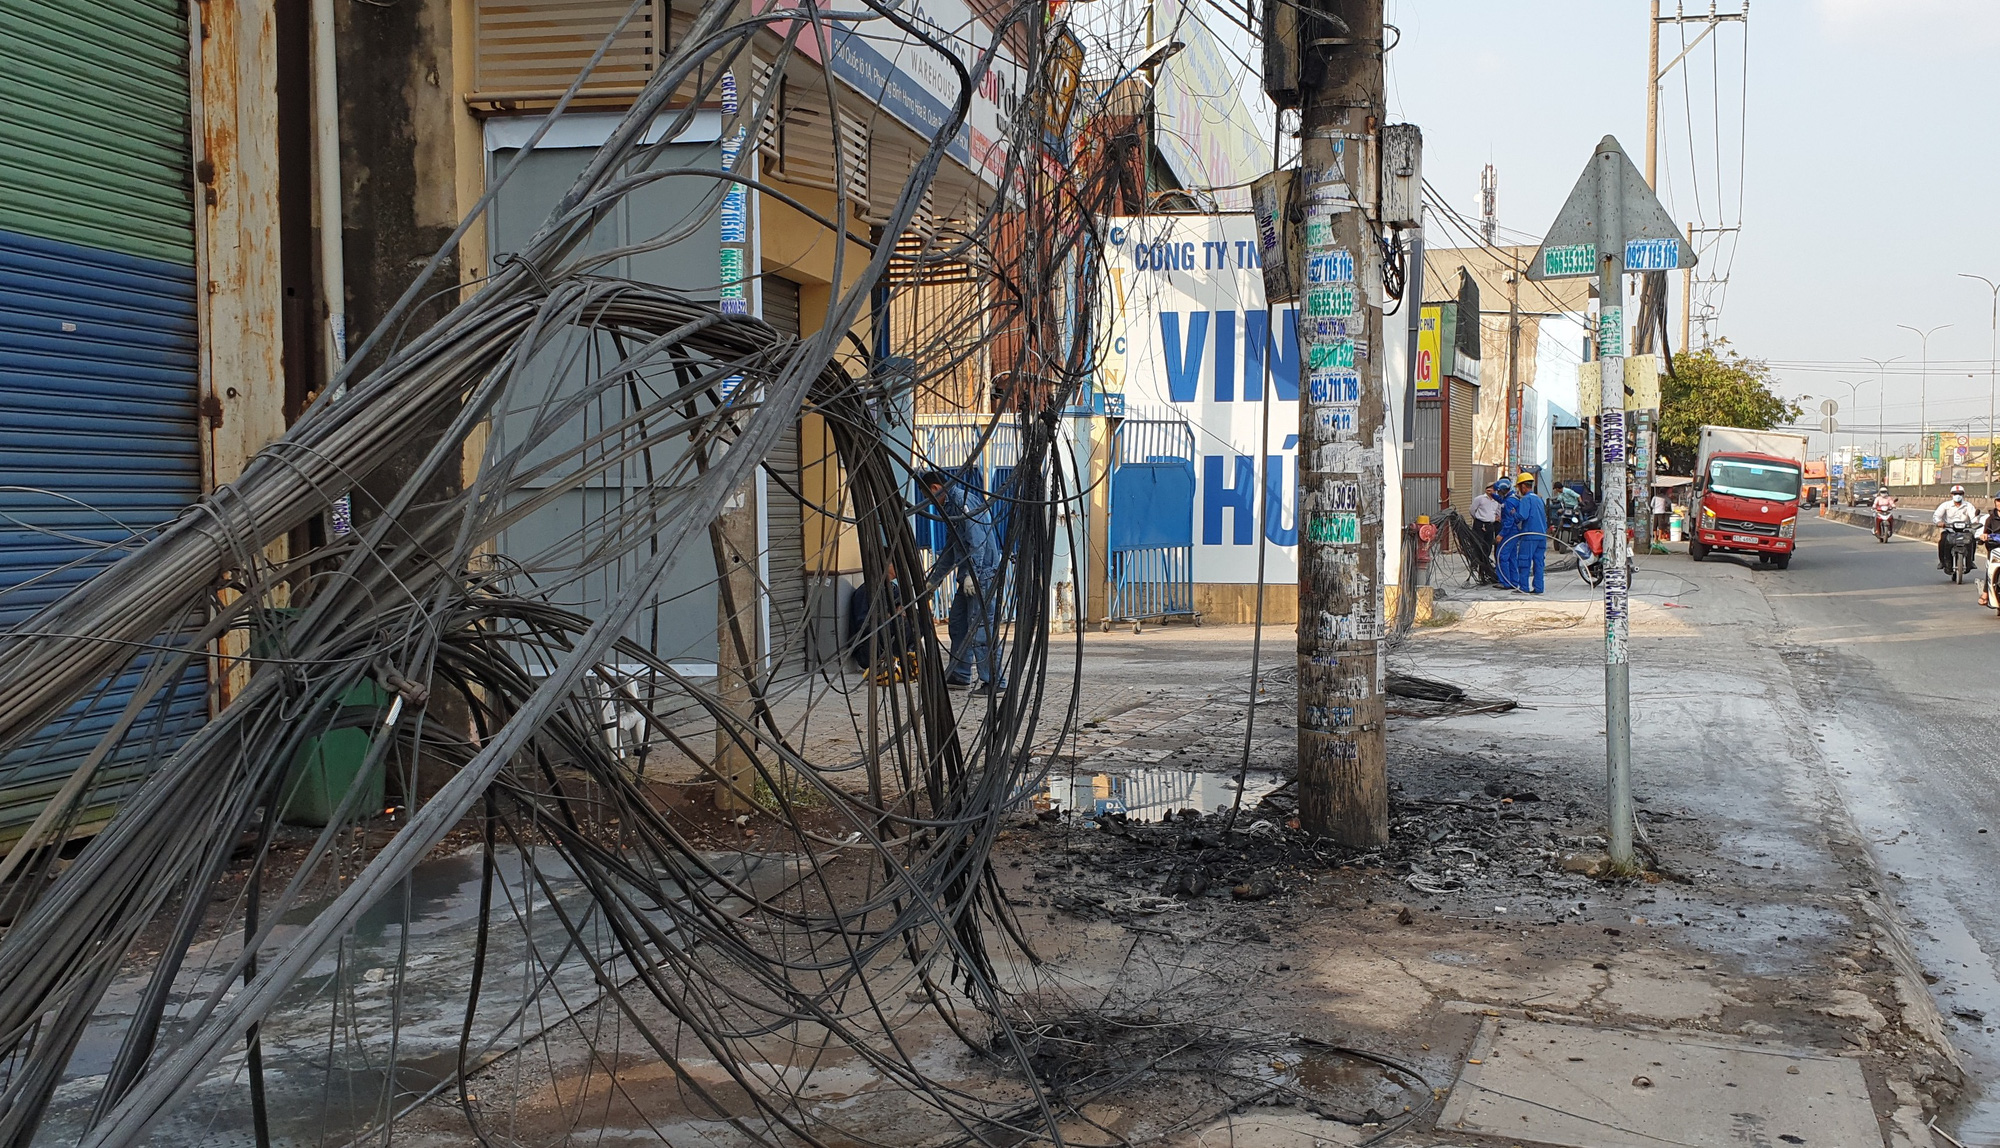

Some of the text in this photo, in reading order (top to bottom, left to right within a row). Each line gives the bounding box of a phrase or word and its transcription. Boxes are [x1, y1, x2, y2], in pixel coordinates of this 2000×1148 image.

[910, 48, 955, 104] WAREHOUSE
[1135, 237, 1195, 271] CÔNG
[1203, 242, 1227, 270] TY
